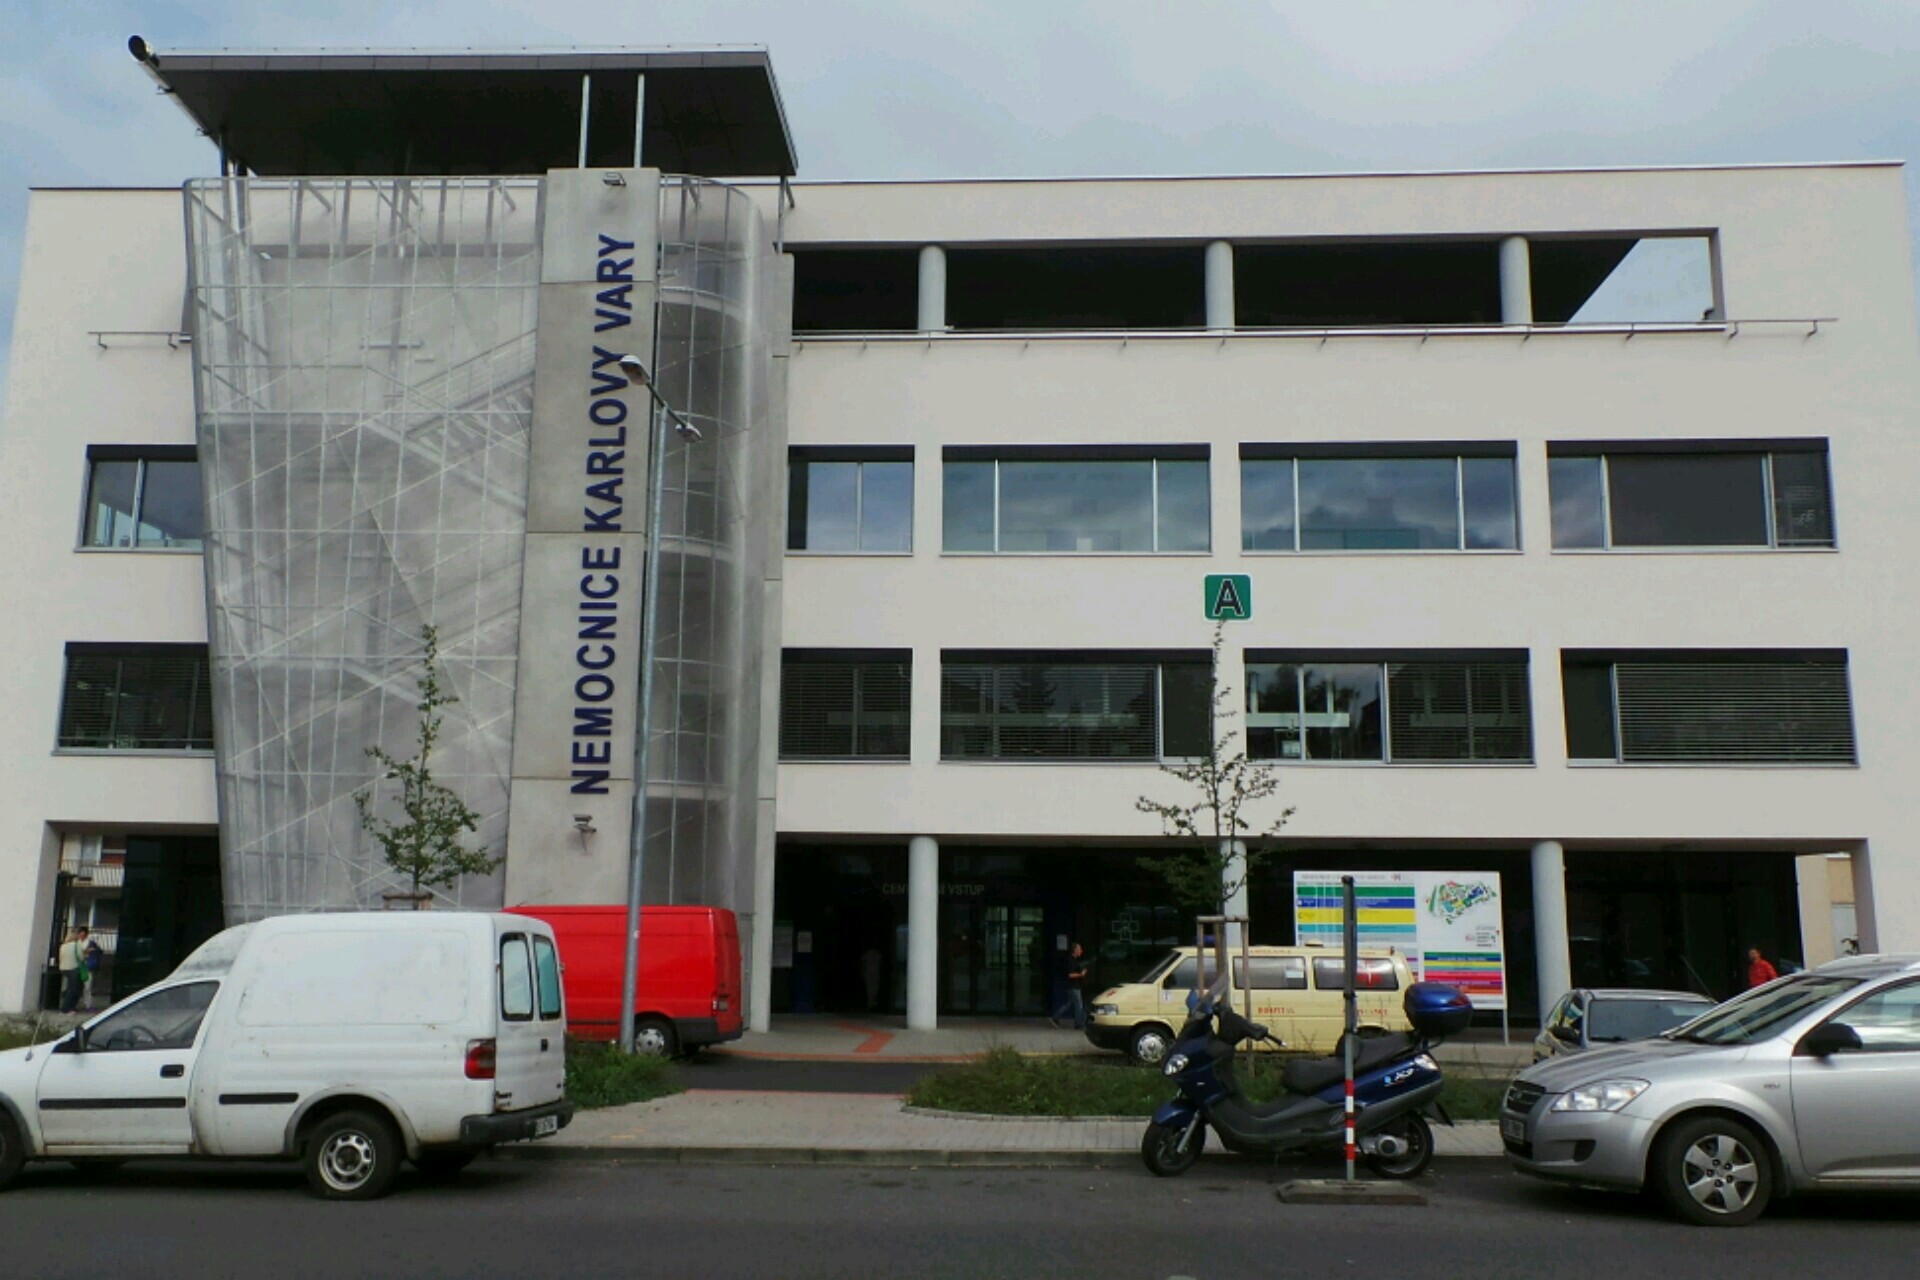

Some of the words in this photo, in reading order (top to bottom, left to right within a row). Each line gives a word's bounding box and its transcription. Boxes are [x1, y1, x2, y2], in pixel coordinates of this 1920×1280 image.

[594, 233, 634, 332] VARY
[584, 345, 629, 532] KARLOVY
[1212, 578, 1245, 617] A
[571, 547, 620, 794] NEMOCNICE
[947, 883, 985, 896] VSTUP
